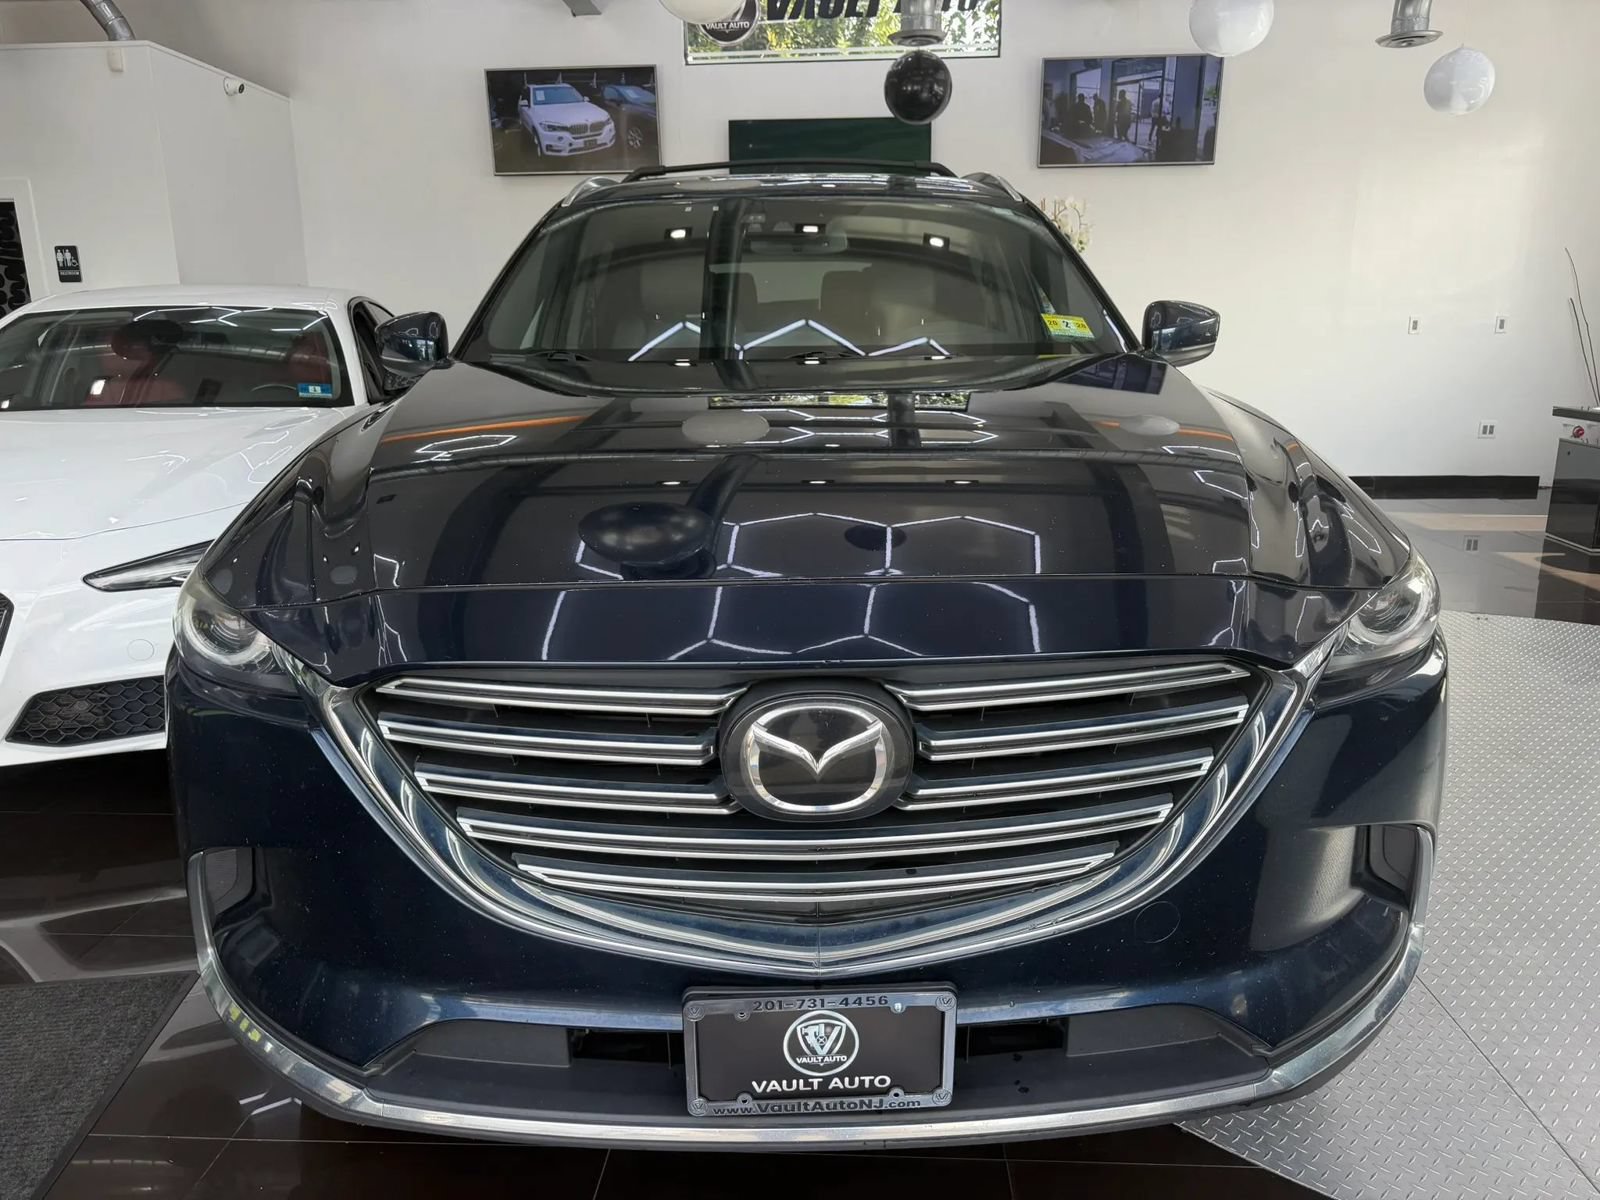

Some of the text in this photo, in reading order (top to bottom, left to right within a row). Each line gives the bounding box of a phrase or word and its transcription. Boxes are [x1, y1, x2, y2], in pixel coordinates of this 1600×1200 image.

[705, 21, 750, 30] VAULT AUTO
[753, 995, 889, 1011] 201-731-4456
[796, 1055, 848, 1064] VAULT AUTO
[751, 1075, 892, 1093] VAULT AUTO
[712, 1099, 921, 1115] www.VaultAutoNJ.com
